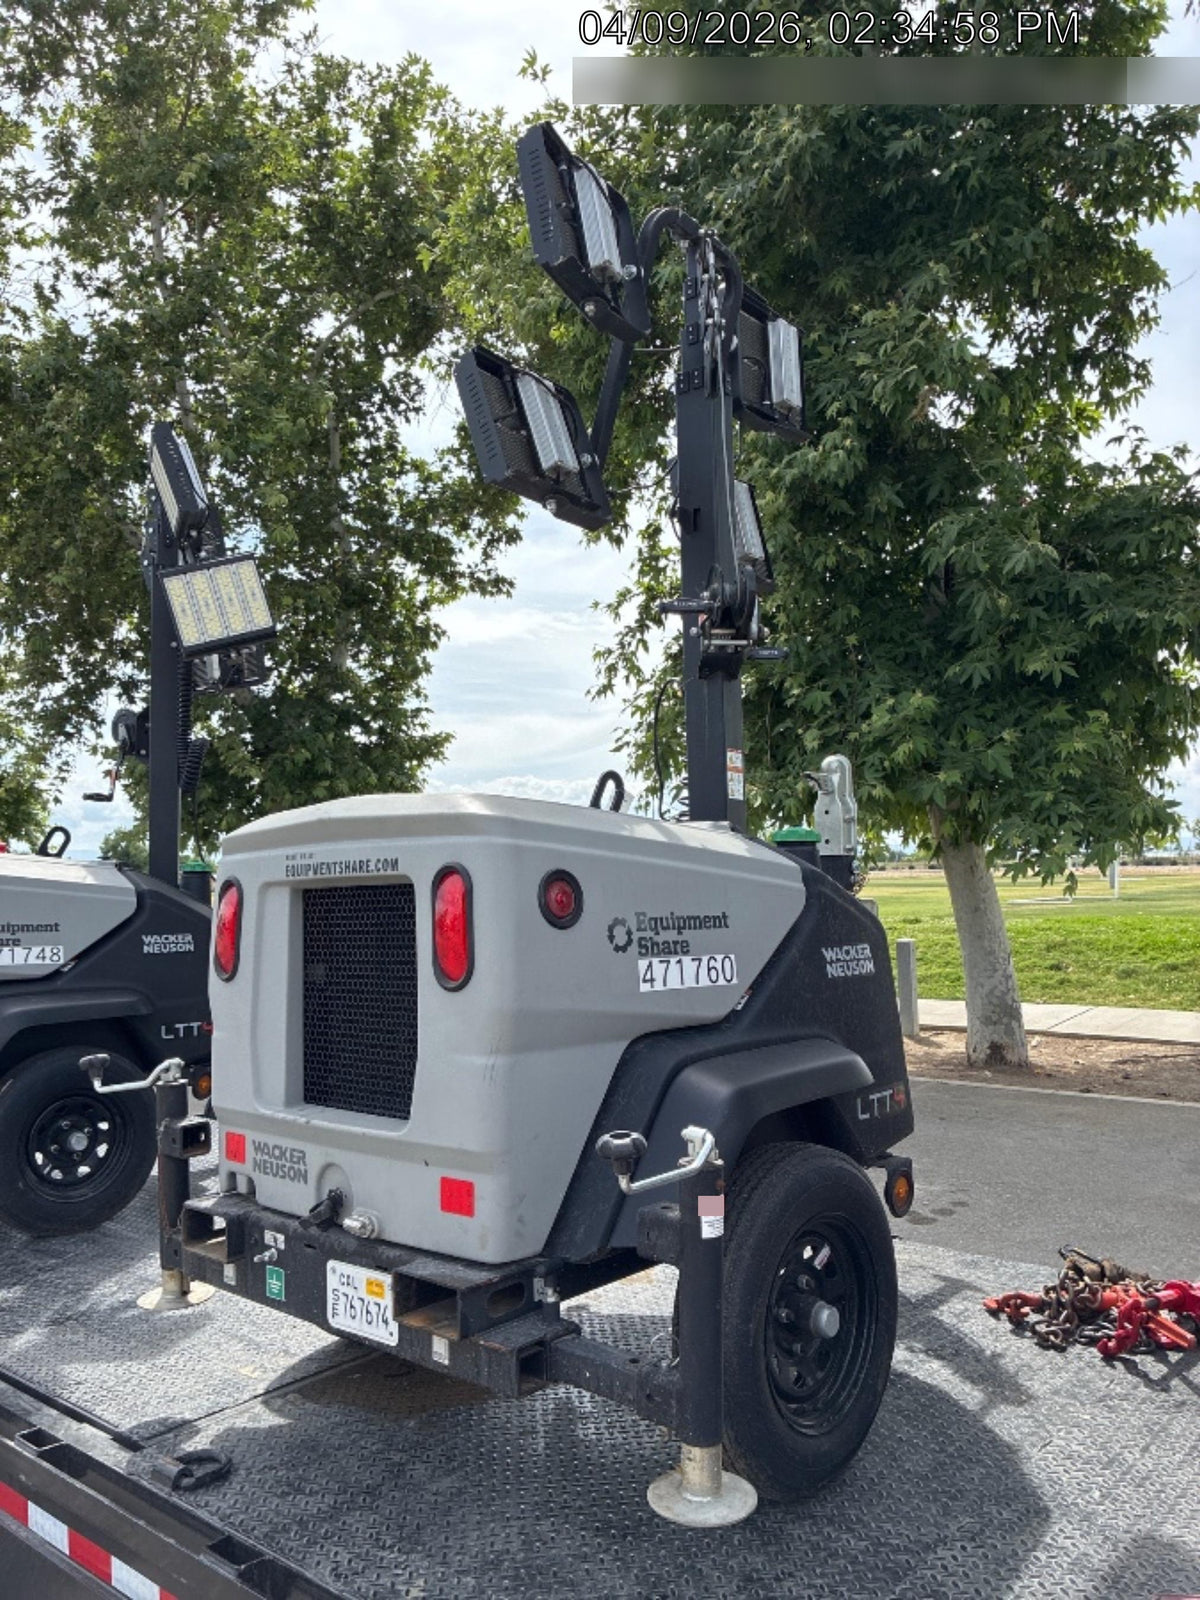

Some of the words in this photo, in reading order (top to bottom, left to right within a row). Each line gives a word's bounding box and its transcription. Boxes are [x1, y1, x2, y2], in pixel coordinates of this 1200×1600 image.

[285, 857, 400, 877] EQUIPMENTSHARE.COM
[634, 911, 729, 935] Equipment
[141, 933, 194, 944] WACKER
[143, 943, 195, 954] NEUSON
[637, 936, 690, 957] Share
[821, 943, 873, 961] WACKER
[641, 955, 735, 989] 471760
[825, 959, 875, 978] NEUSON
[252, 1139, 307, 1167] WACKER
[252, 1157, 308, 1185] NEUSON
